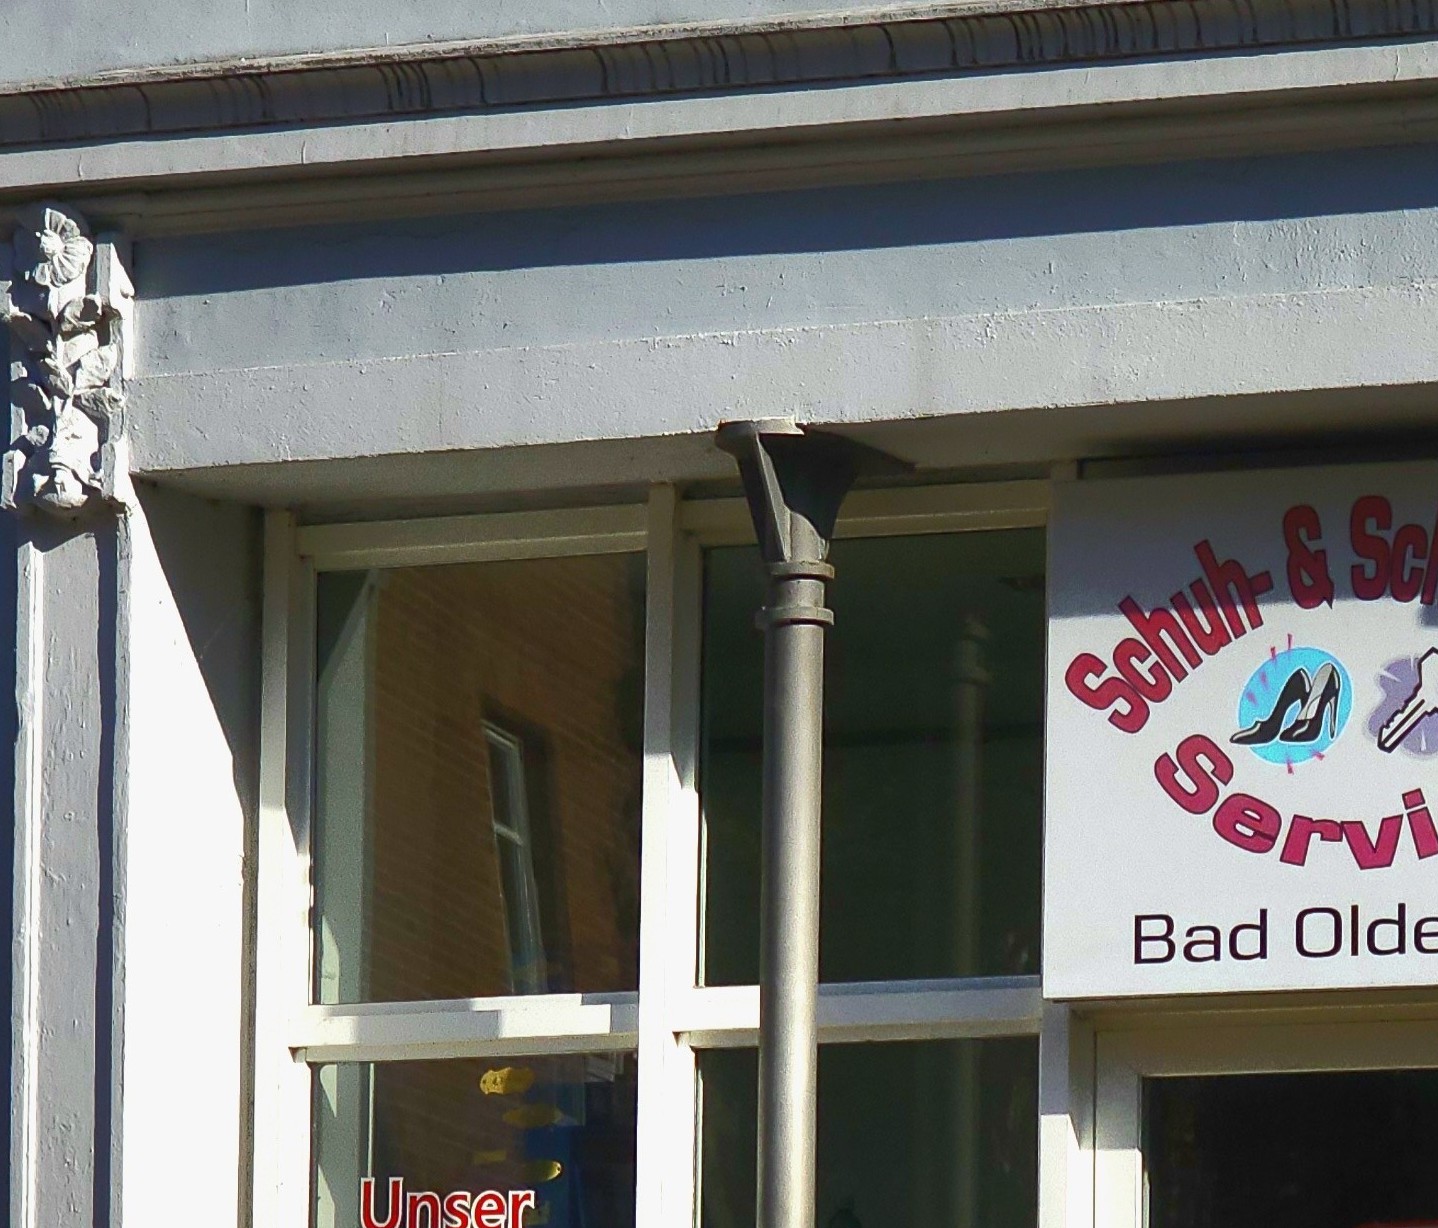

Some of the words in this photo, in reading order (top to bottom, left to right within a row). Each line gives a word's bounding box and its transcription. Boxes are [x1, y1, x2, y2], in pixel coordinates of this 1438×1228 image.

[1065, 540, 1273, 734] Schuh-
[1283, 504, 1334, 609] &
[1133, 909, 1268, 965] Bad
